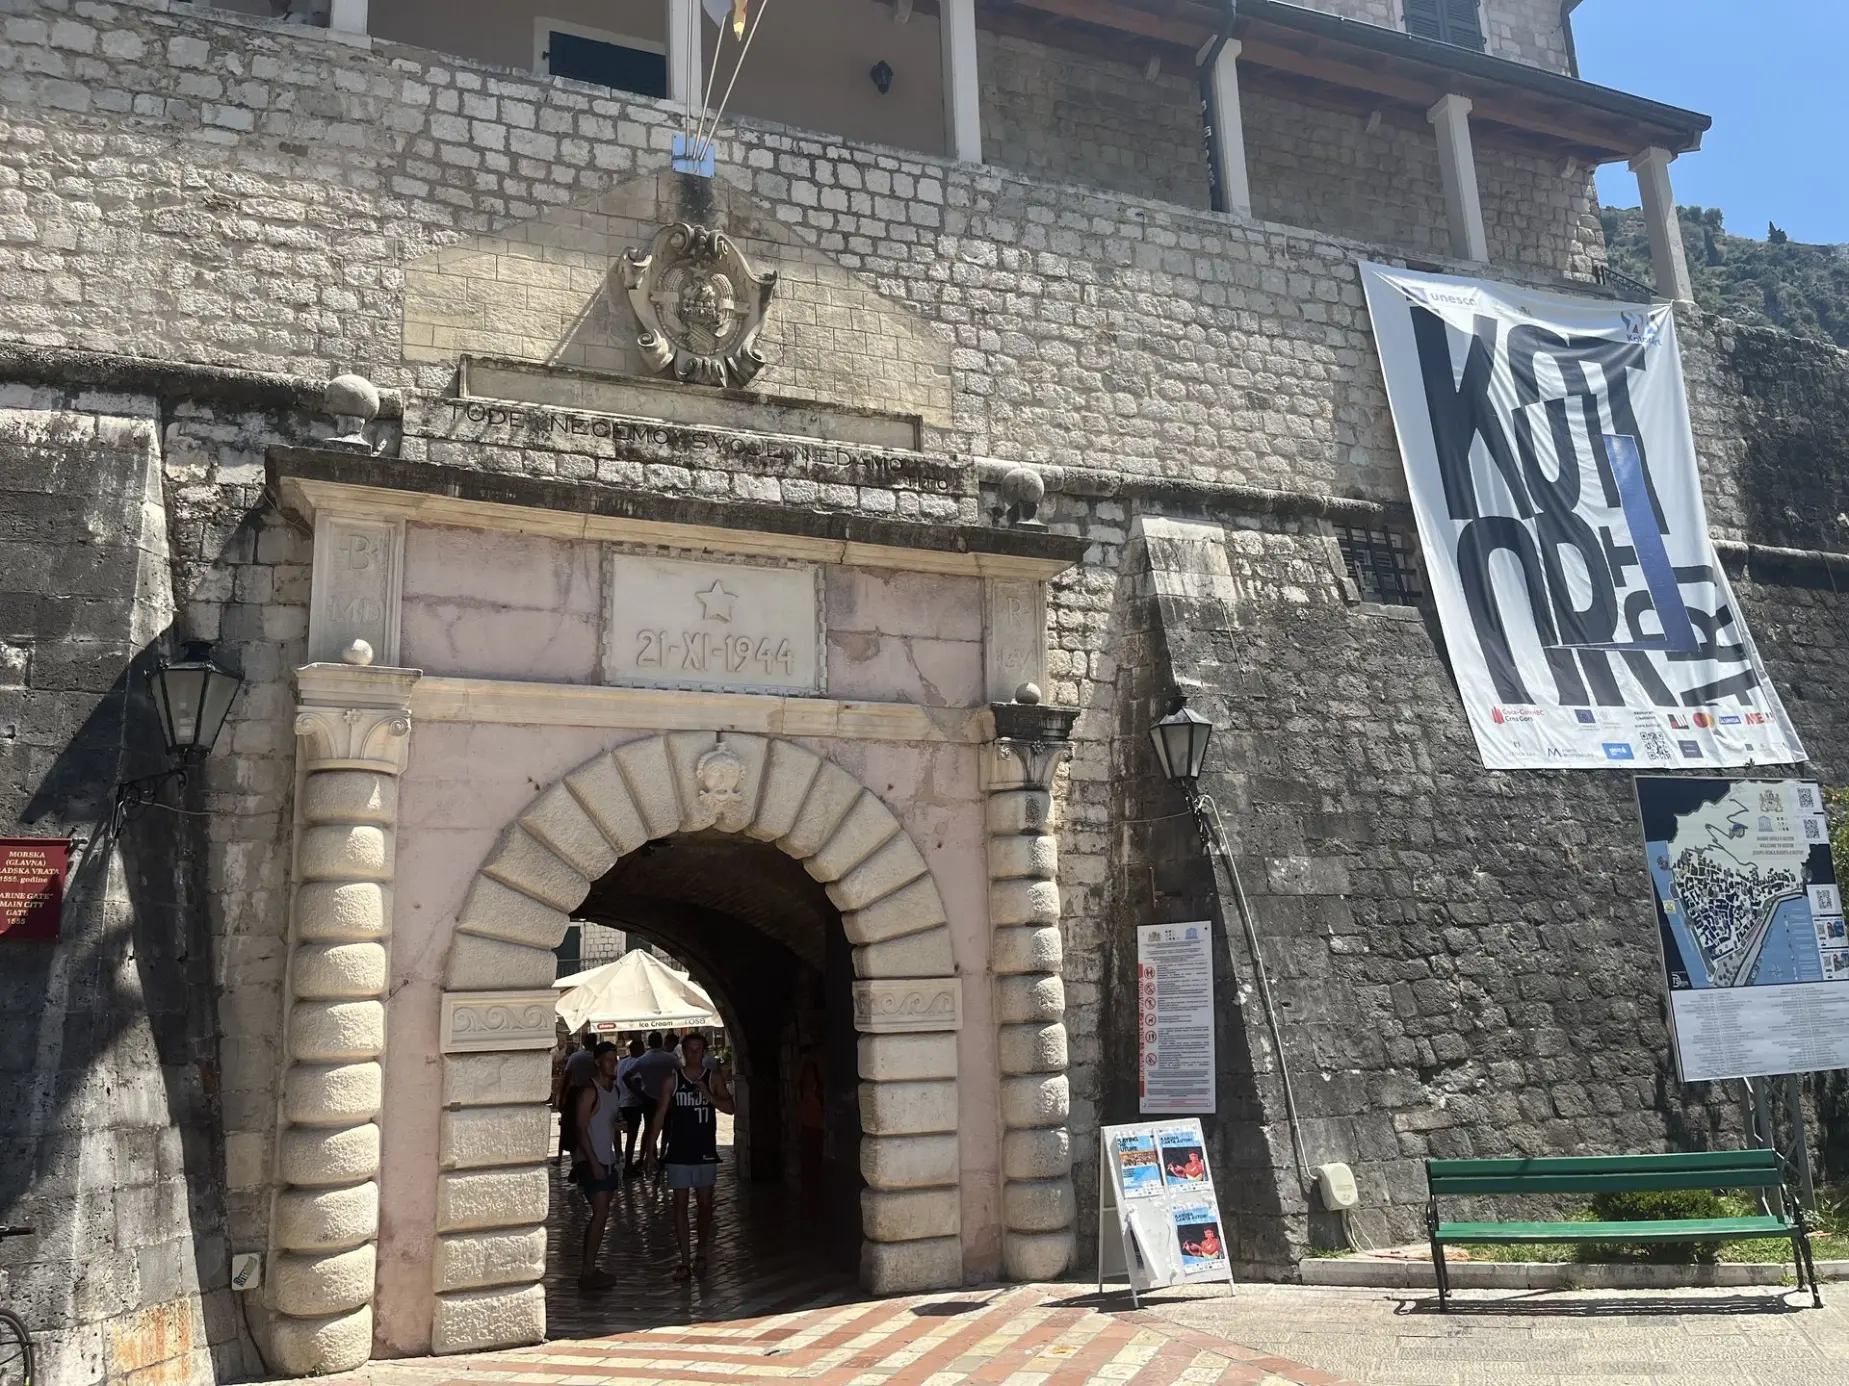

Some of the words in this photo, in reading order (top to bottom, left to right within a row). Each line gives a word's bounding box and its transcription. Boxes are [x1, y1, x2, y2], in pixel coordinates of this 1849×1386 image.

[1431, 291, 1475, 307] unesco
[691, 433, 784, 459] SVOJE
[636, 628, 796, 677] 21-XI-1944
[20, 876, 48, 884] godine
[694, 1107, 709, 1124] 77
